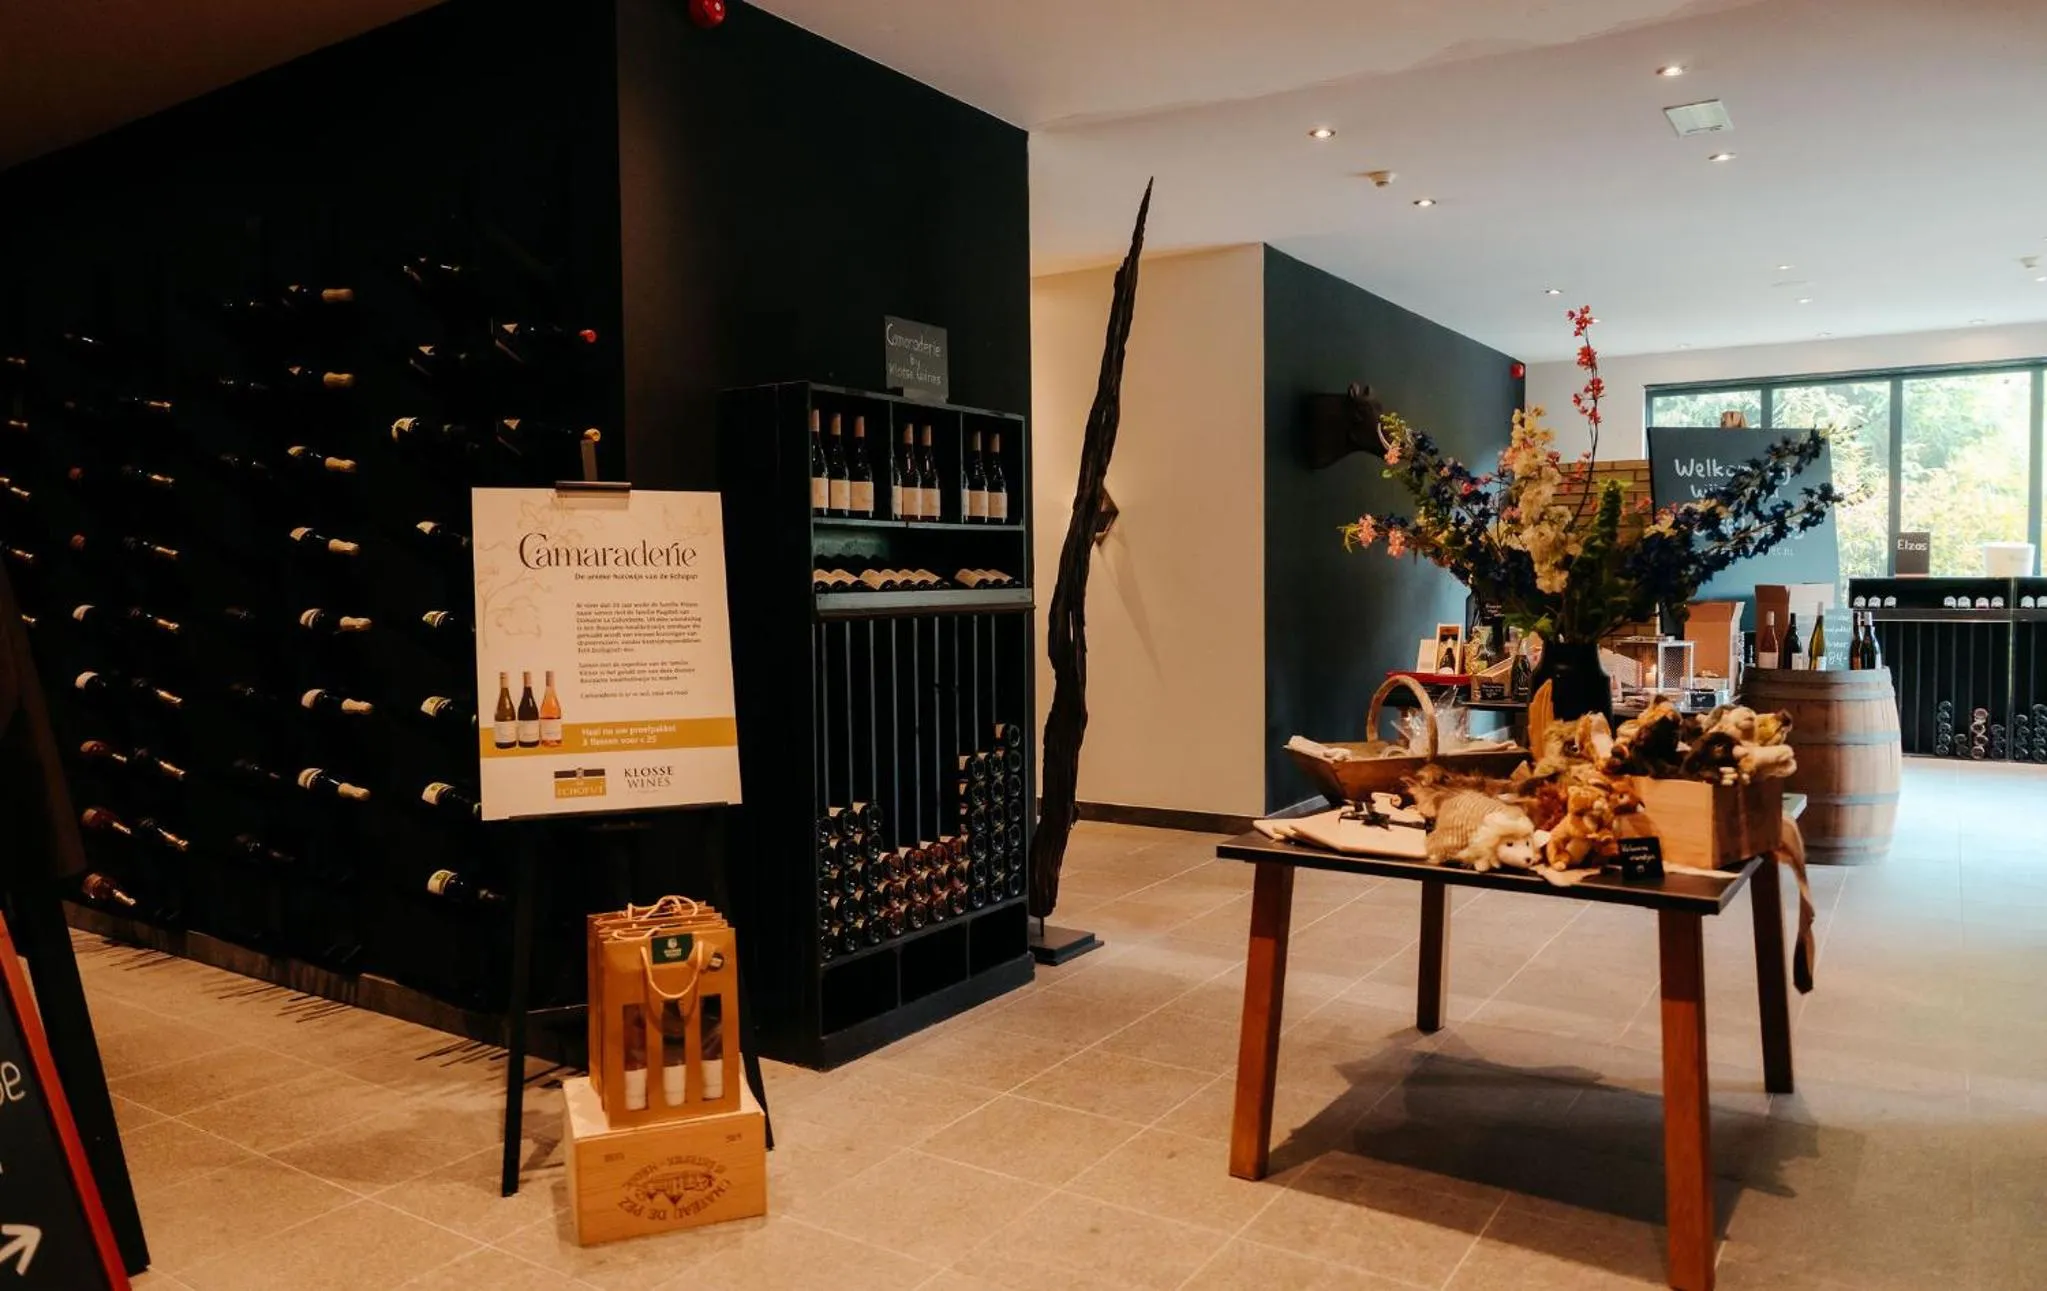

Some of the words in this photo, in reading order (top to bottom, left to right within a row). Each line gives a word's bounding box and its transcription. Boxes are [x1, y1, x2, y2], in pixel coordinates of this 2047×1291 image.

[518, 532, 697, 570] Camaraderie
[1897, 539, 1928, 551] Elzas
[581, 728, 601, 736] Haal
[624, 765, 674, 778] KLOSSE
[627, 777, 672, 789] WINES
[647, 1209, 667, 1221] DE
